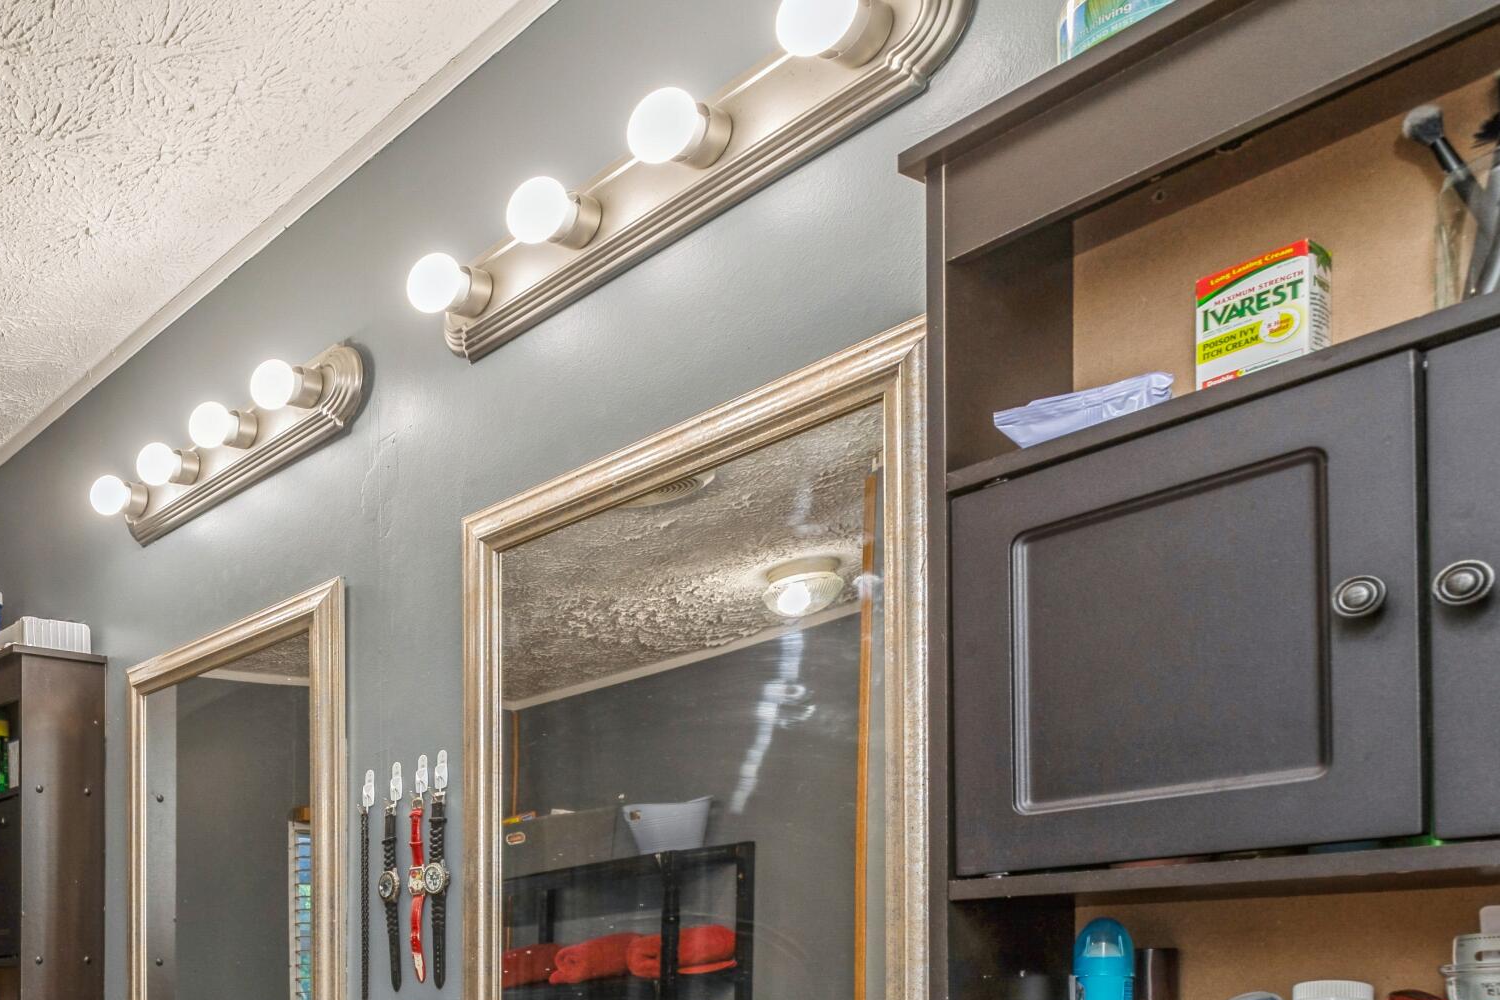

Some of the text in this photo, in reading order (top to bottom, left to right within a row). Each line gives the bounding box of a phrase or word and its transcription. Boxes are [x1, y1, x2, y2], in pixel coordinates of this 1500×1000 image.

[1209, 273, 1231, 286] Long
[1232, 259, 1262, 275] Lasting
[1264, 247, 1294, 261] Cream
[1202, 278, 1304, 332] IVAREST
[1214, 286, 1255, 306] MAXIMUM
[1258, 269, 1304, 290] STRENGTH
[1203, 332, 1237, 352] POISON
[1240, 326, 1256, 337] IVY
[1203, 335, 1260, 360] ITCH CREAM
